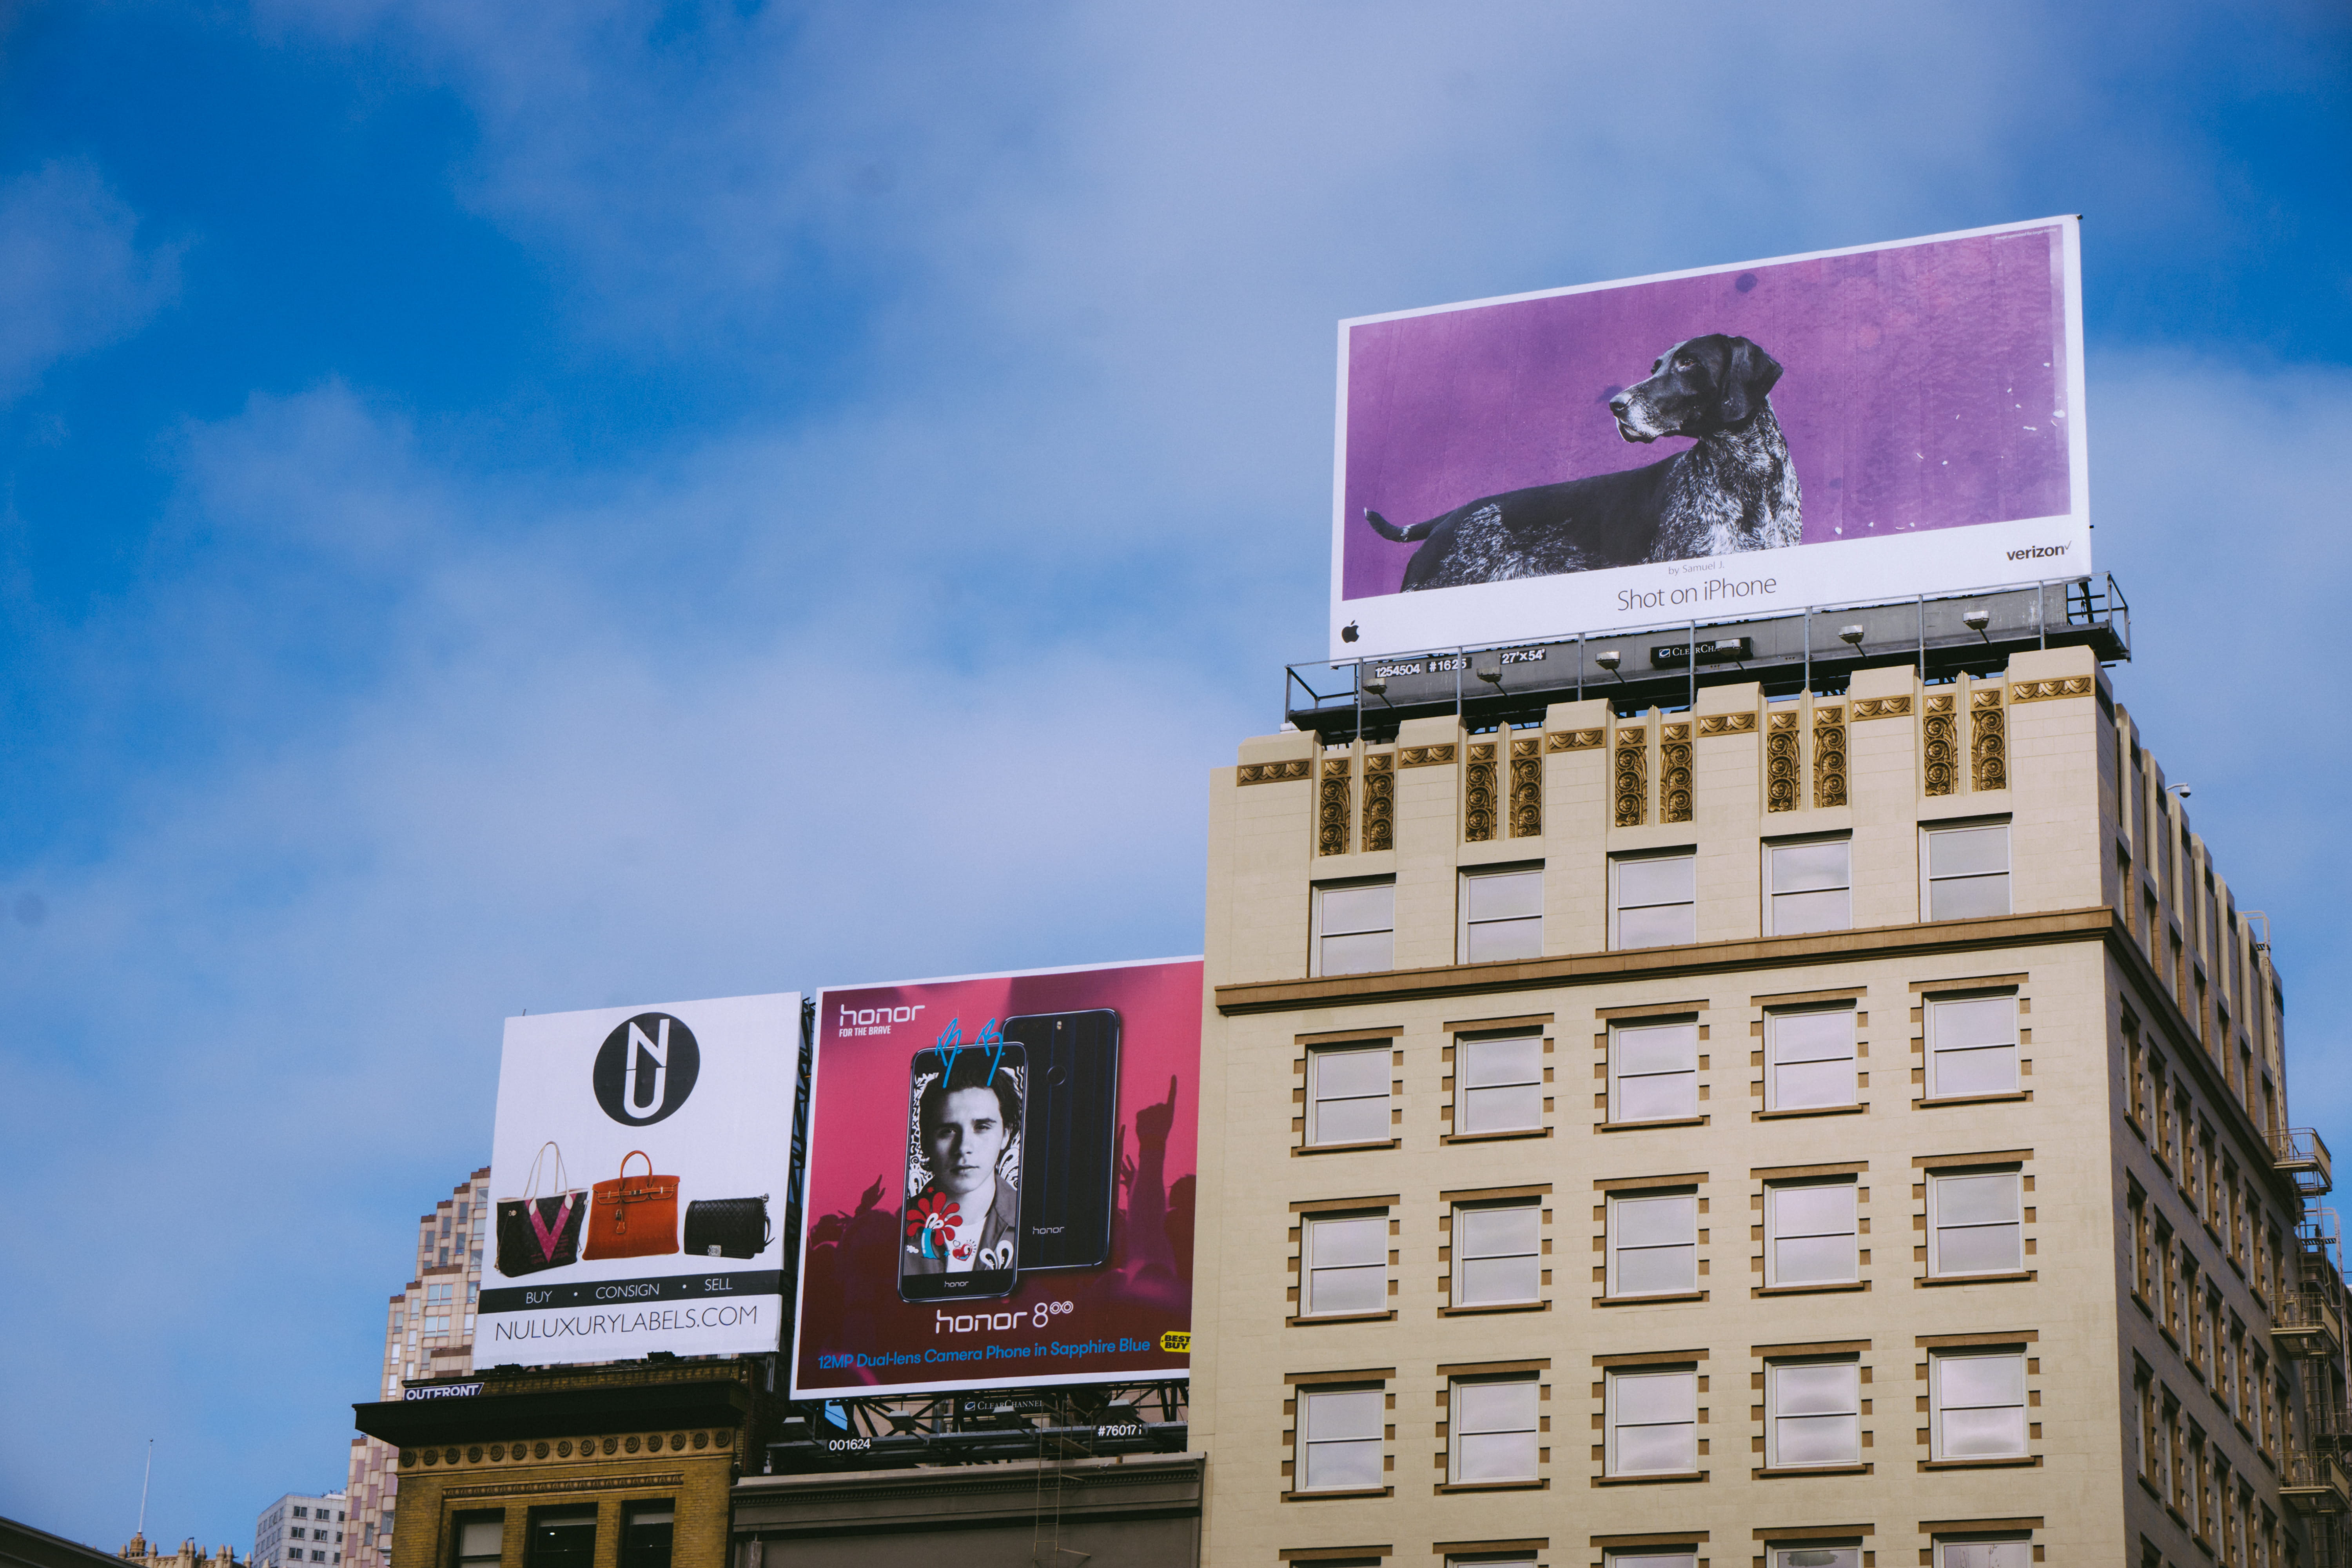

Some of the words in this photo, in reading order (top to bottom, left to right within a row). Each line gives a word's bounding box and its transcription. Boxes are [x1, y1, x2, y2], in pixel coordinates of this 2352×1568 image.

[2006, 545, 2065, 561] verizon
[1668, 566, 1680, 576] by
[1682, 561, 1715, 573] Samuel
[1719, 561, 1725, 569] J.
[1618, 589, 1665, 611] Shot
[1671, 588, 1697, 604] on
[1704, 578, 1777, 601] iPhone
[1376, 663, 1420, 678] 1254504
[840, 1004, 925, 1026] honor
[839, 1029, 853, 1038] FOR
[855, 1027, 867, 1036] THE
[869, 1025, 891, 1035] BRAVE
[1033, 1226, 1065, 1235] honor
[526, 1291, 552, 1304] BUY
[596, 1283, 660, 1299] CONSIGN
[705, 1278, 733, 1291] SELL
[495, 1305, 758, 1341] NULUXURYLABELS.COM
[936, 1309, 1028, 1334] honor
[818, 1354, 854, 1369] 12MP
[857, 1352, 921, 1367] Dual-lens
[924, 1349, 982, 1363] Camera
[986, 1345, 1031, 1359] Phone
[1035, 1343, 1047, 1356] in
[1051, 1339, 1116, 1358] Sapphire
[1120, 1338, 1150, 1352] Blue
[406, 1385, 479, 1401] OUTFRONT
[829, 1438, 871, 1451] 001624
